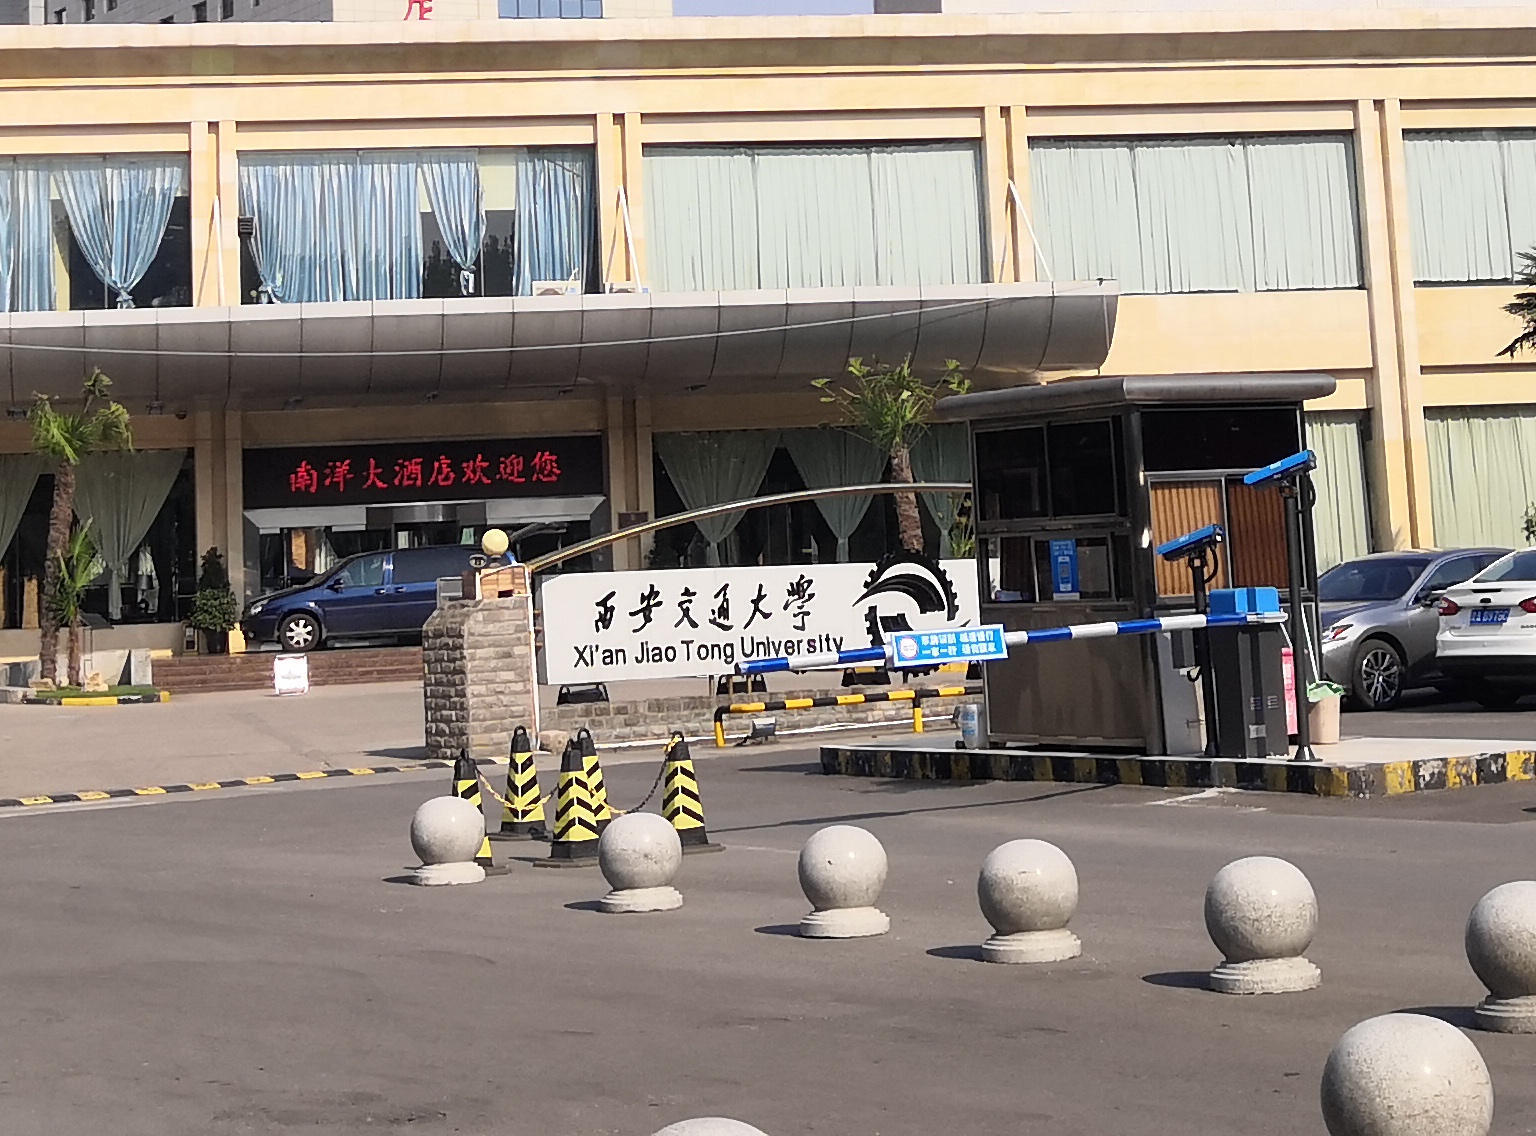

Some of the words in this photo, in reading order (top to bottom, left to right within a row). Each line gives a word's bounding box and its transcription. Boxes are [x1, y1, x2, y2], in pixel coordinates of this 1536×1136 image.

[289, 451, 561, 493] 南洋大酒店欢迎您
[573, 644, 627, 668] Xi'an
[634, 640, 677, 664] Jiao
[680, 639, 735, 665] Tong
[740, 633, 844, 658] University
